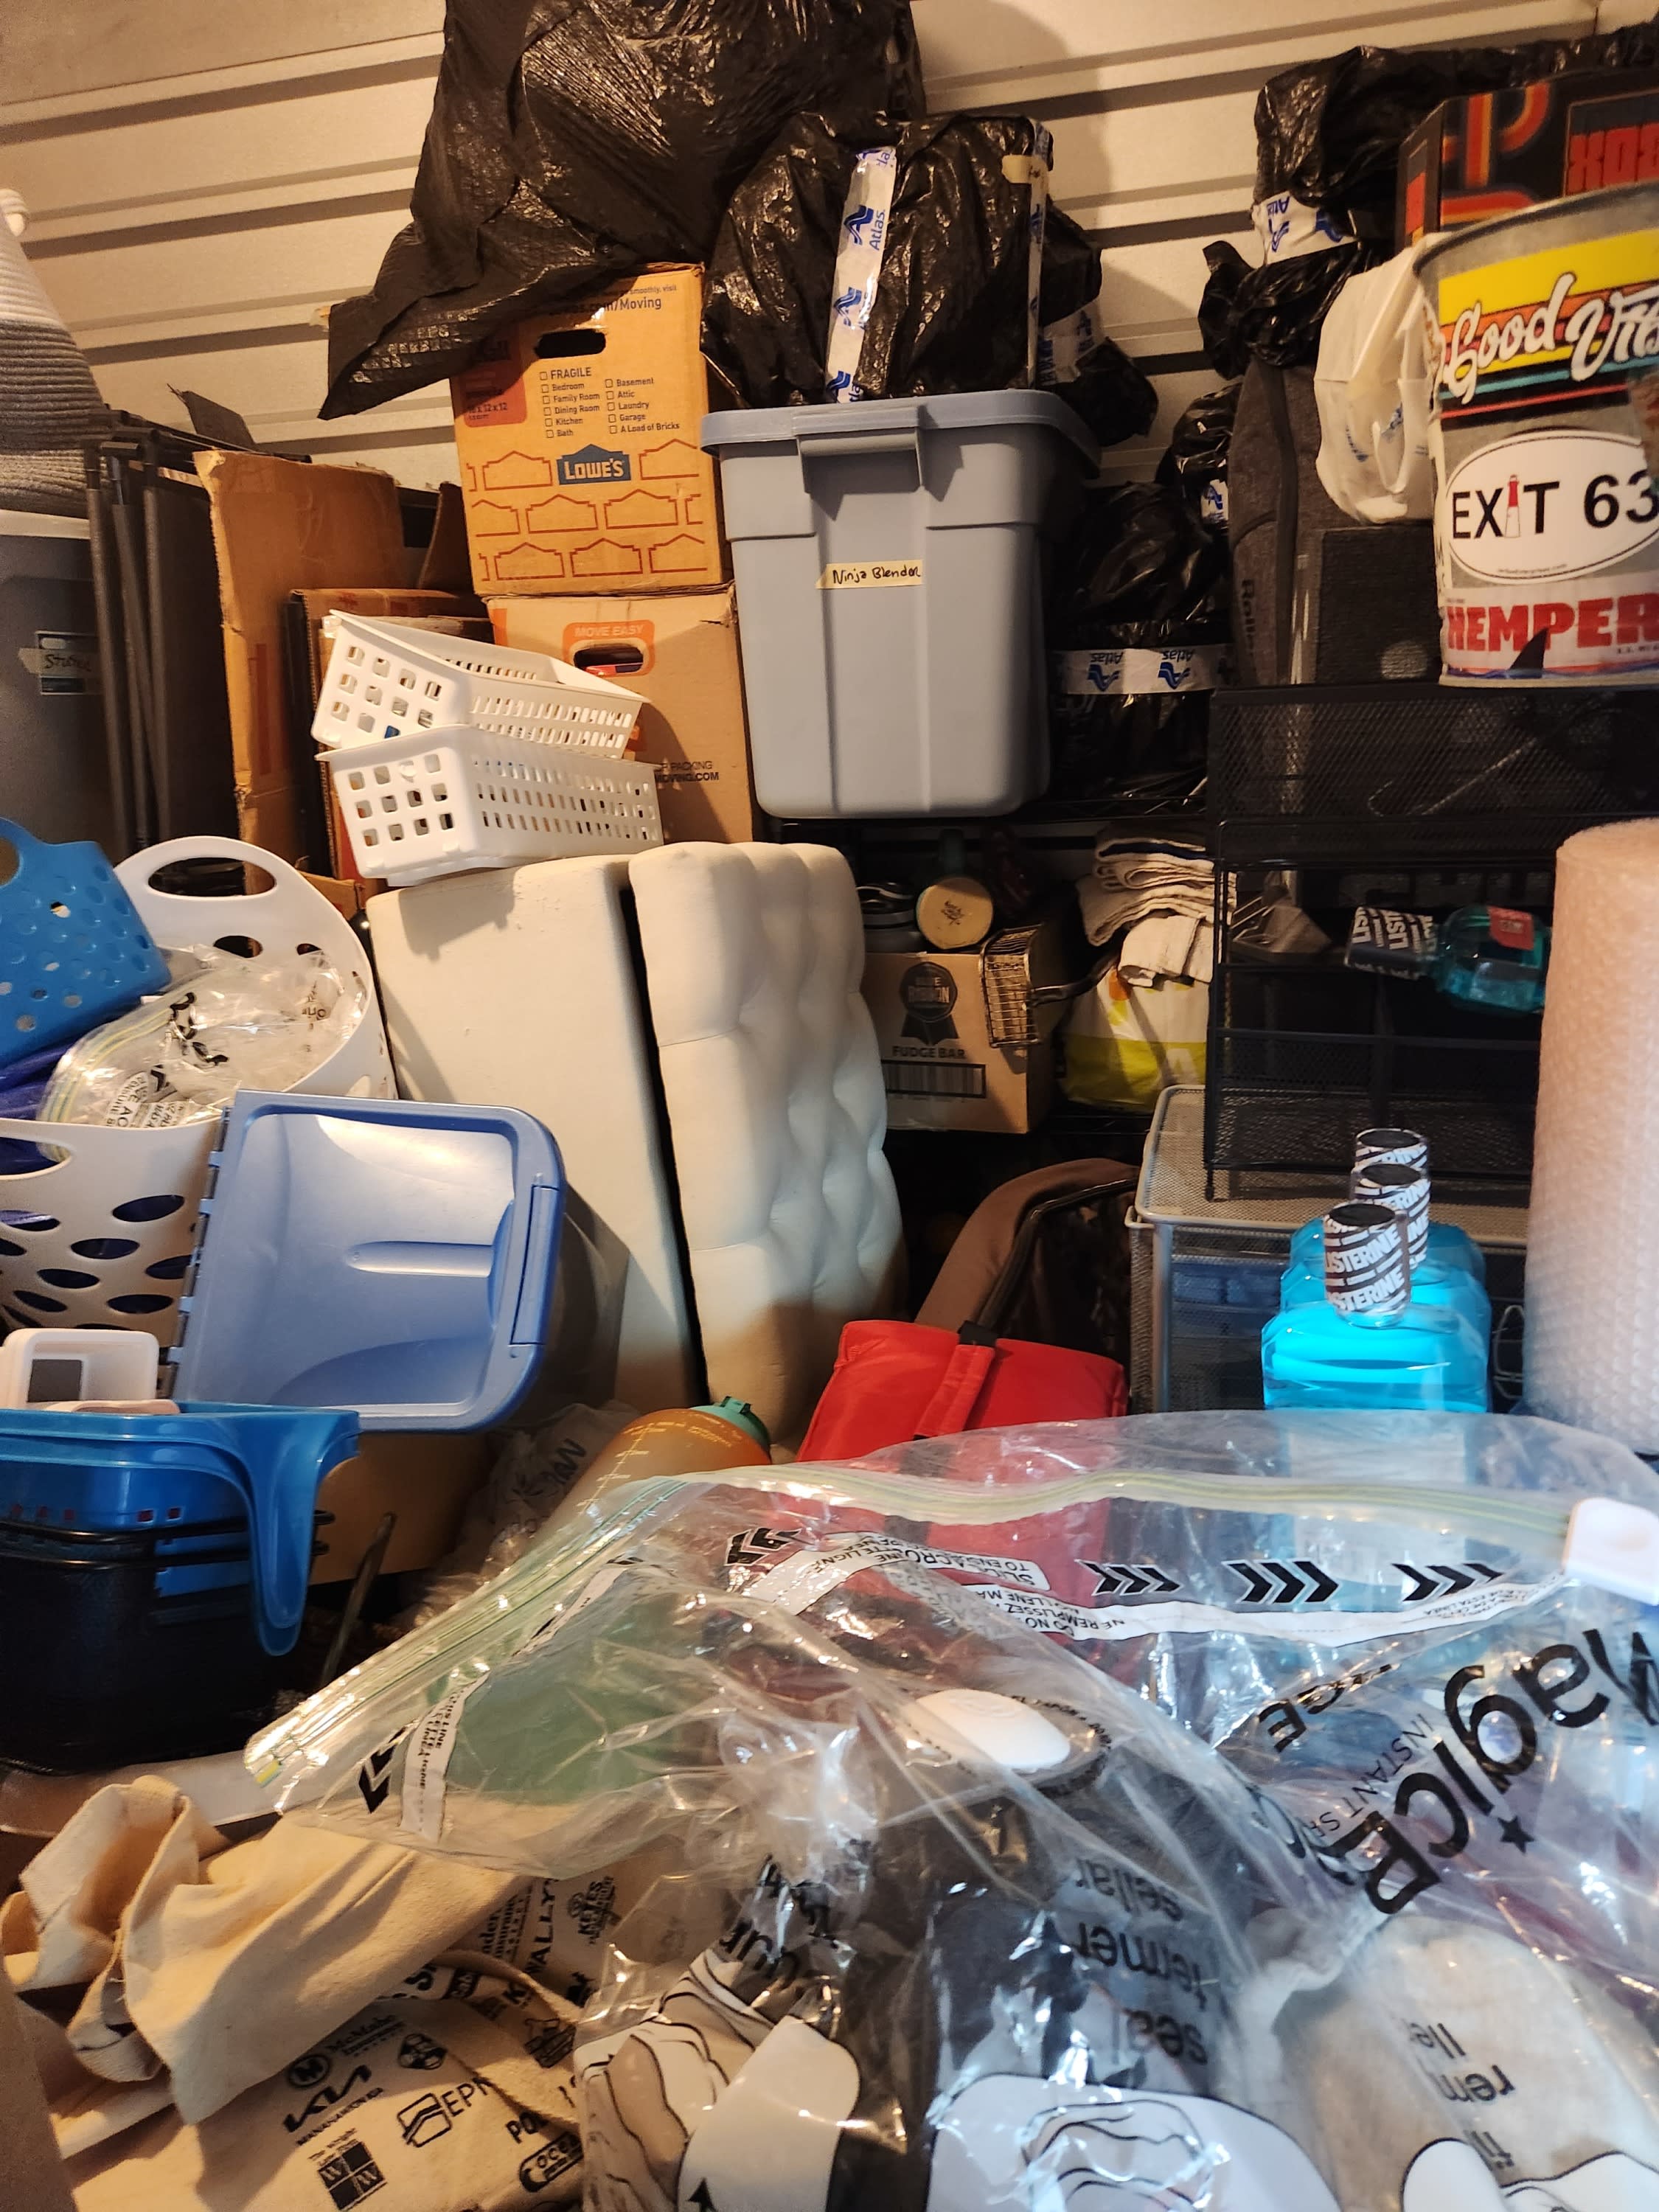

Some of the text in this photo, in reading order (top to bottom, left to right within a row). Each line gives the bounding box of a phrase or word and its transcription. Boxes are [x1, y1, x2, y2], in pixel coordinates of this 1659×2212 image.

[868, 211, 886, 251] Atlas
[1443, 272, 1577, 405] Good
[550, 367, 592, 380] FRAGILE
[552, 383, 585, 392] Bedroom
[616, 378, 654, 387] Basement
[553, 393, 600, 403] Family Room
[618, 390, 636, 399] Attic
[554, 405, 600, 415] Dining Room
[618, 402, 650, 411] Laundry
[555, 417, 583, 425] Kitchen
[619, 414, 646, 422] Garage
[627, 424, 646, 432] Load
[647, 423, 655, 431] of
[655, 422, 680, 431] Bricks
[563, 458, 625, 480] LOWE'S
[1583, 467, 1659, 529] 63
[832, 568, 867, 585] Ninja
[574, 625, 644, 638] MOVE EASY
[1161, 650, 1197, 664] Atlas
[938, 1047, 967, 1059] BAR
